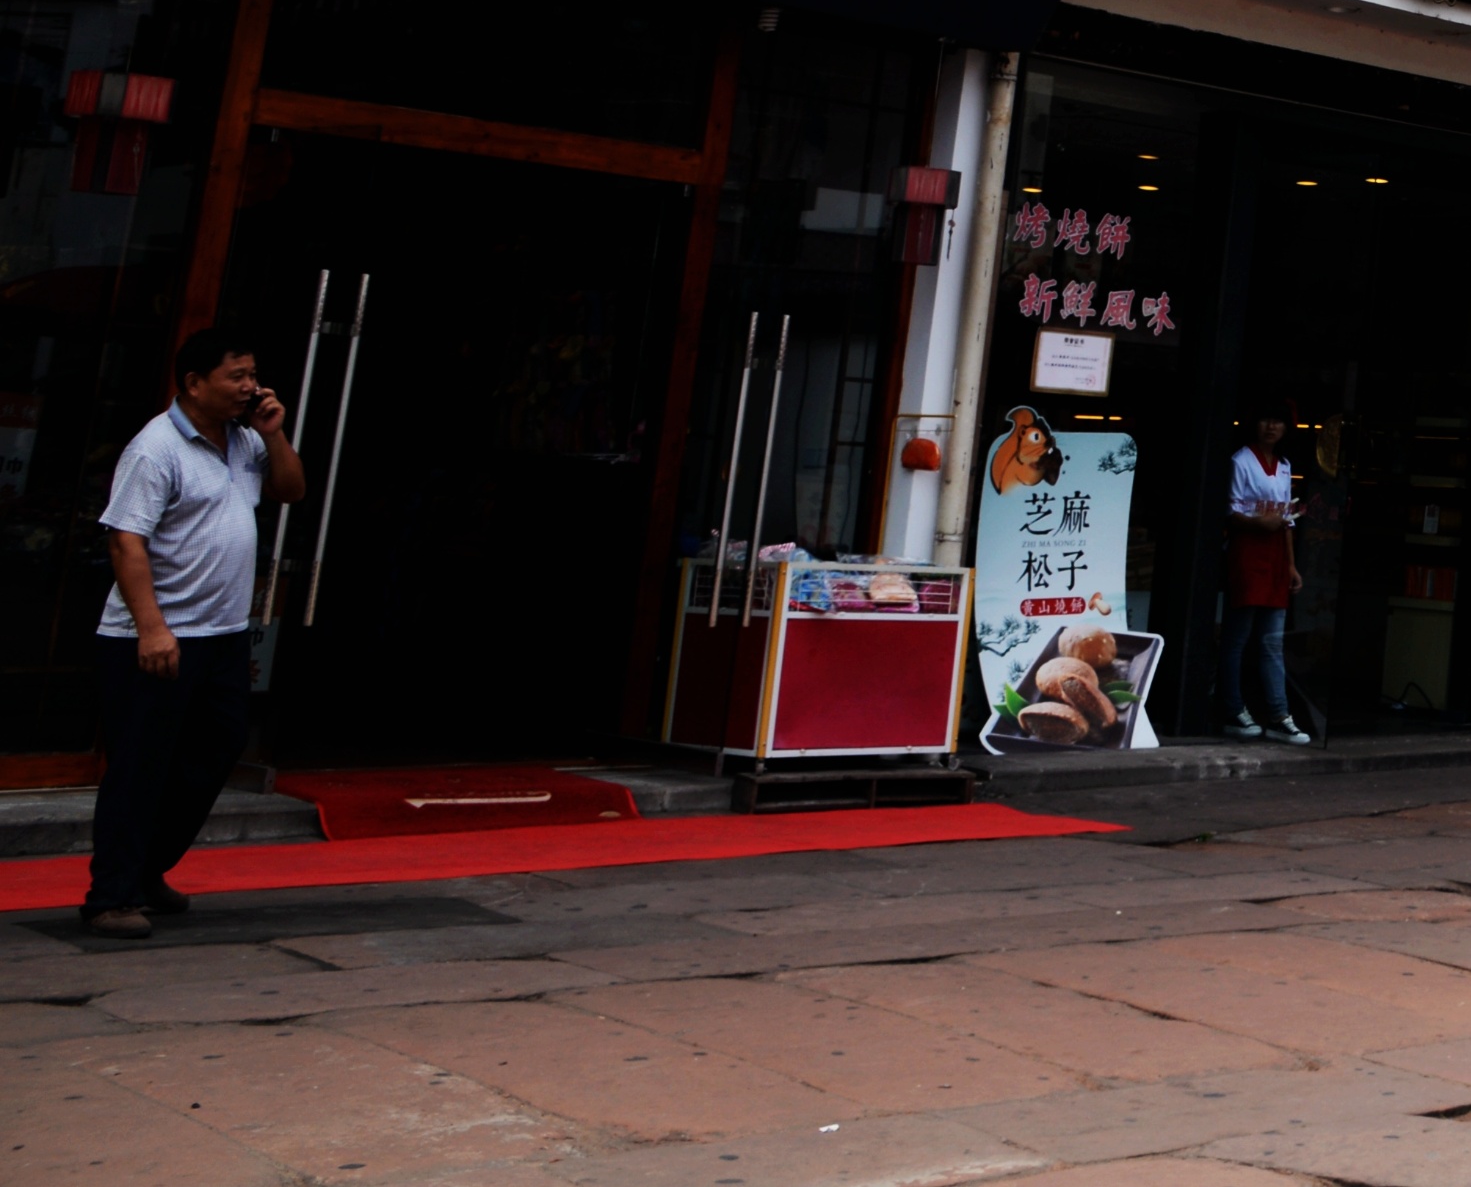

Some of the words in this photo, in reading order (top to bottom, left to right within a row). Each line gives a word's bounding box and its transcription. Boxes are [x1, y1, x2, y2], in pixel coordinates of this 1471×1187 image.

[1019, 273, 1175, 336] 新鮮風味
[1019, 491, 1091, 537] 芝麻
[1054, 540, 1076, 548] SONG
[1016, 550, 1088, 592] 松子
